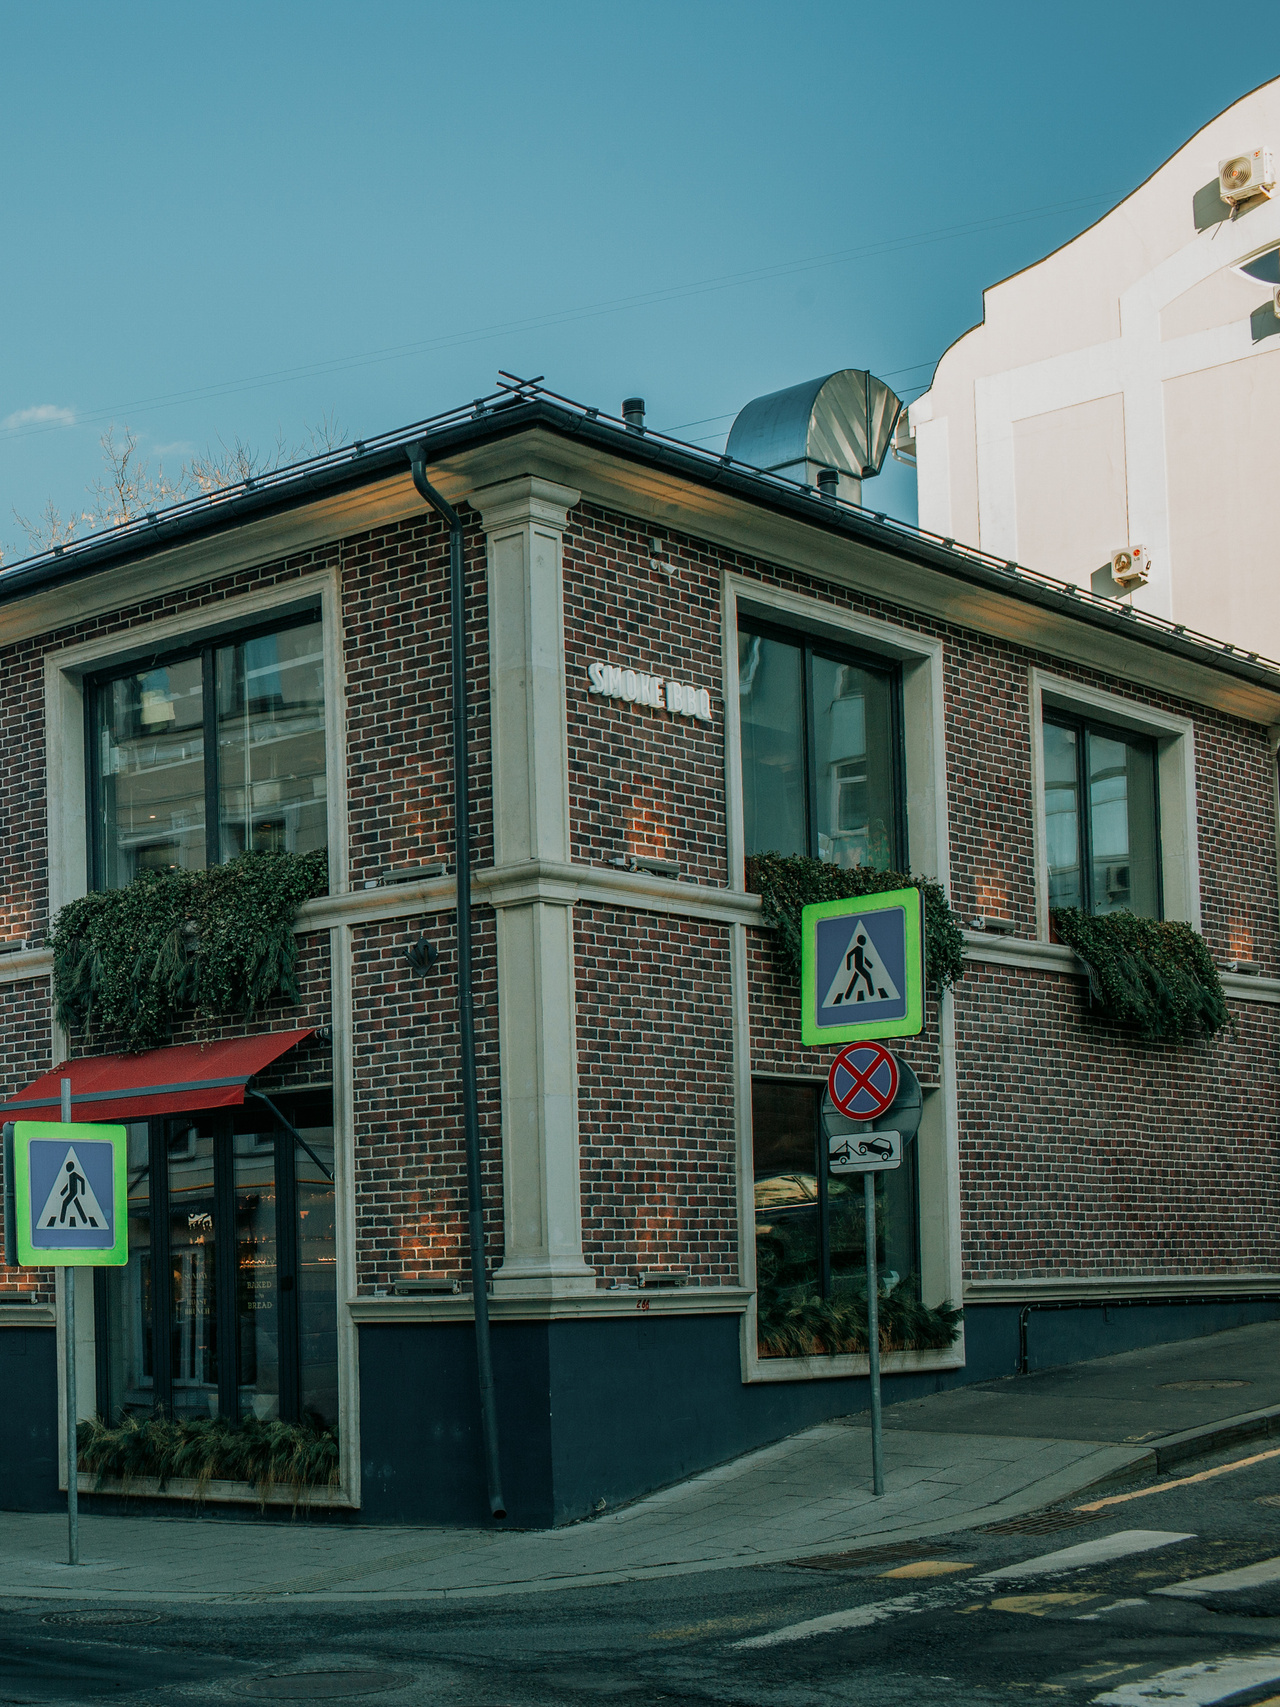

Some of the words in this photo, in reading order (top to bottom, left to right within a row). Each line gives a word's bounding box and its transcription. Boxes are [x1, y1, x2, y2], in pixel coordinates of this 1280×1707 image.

[588, 662, 665, 708] SMOKE
[666, 681, 712, 719] BBQ
[247, 1281, 272, 1289] BAKED
[247, 1301, 273, 1309] BREAD
